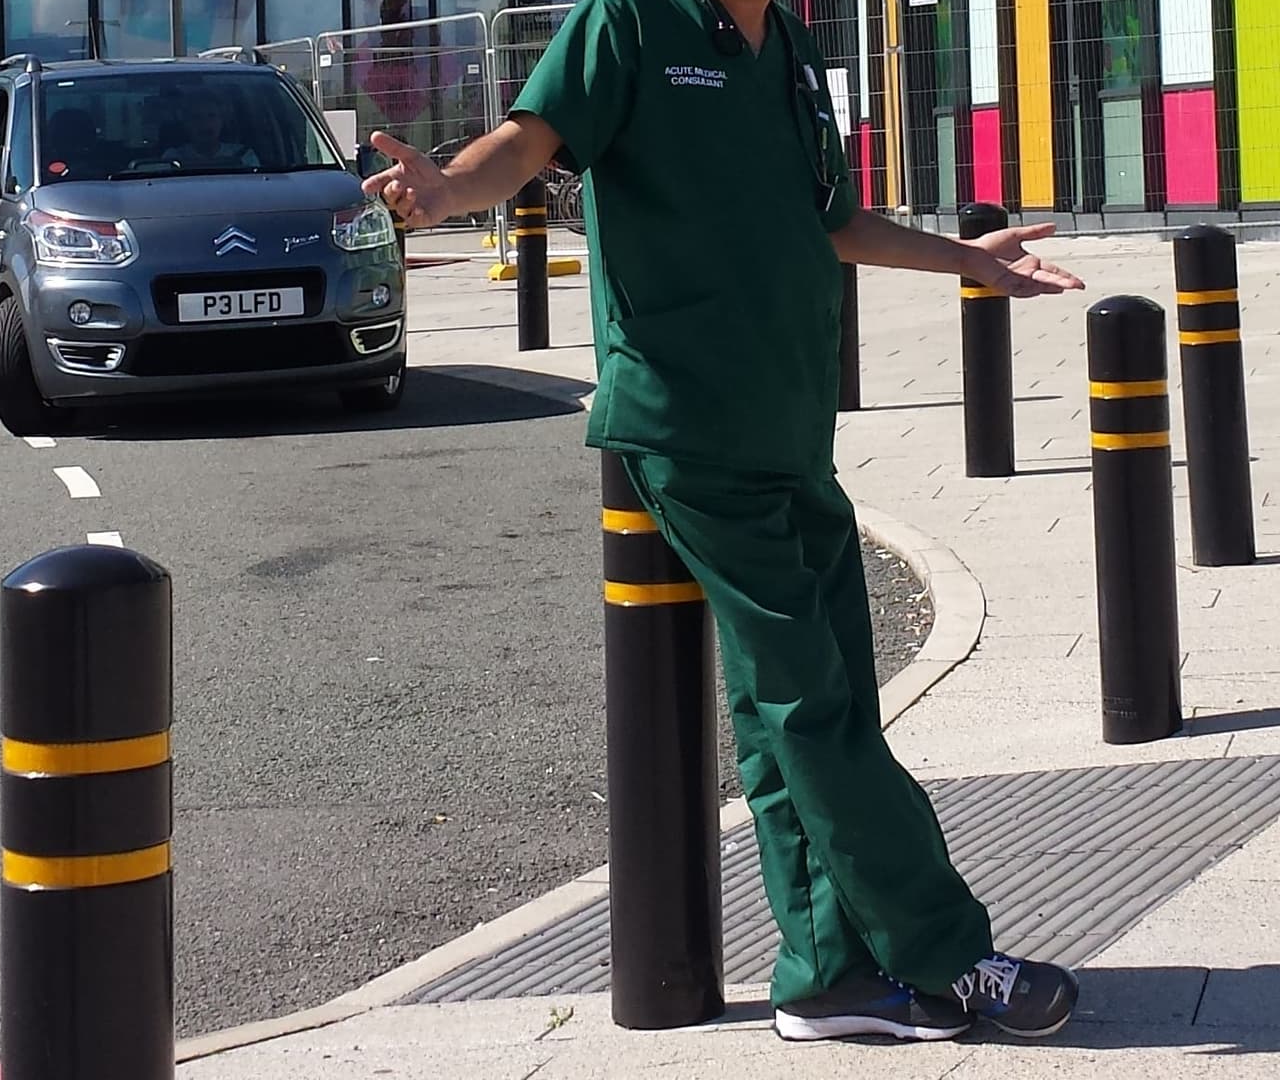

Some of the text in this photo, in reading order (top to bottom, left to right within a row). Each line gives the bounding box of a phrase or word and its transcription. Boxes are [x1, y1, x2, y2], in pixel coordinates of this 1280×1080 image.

[665, 66, 728, 80] ACUTE MEDICAL
[670, 76, 724, 88] CONSULTANT
[203, 291, 281, 317] P3 LFD
